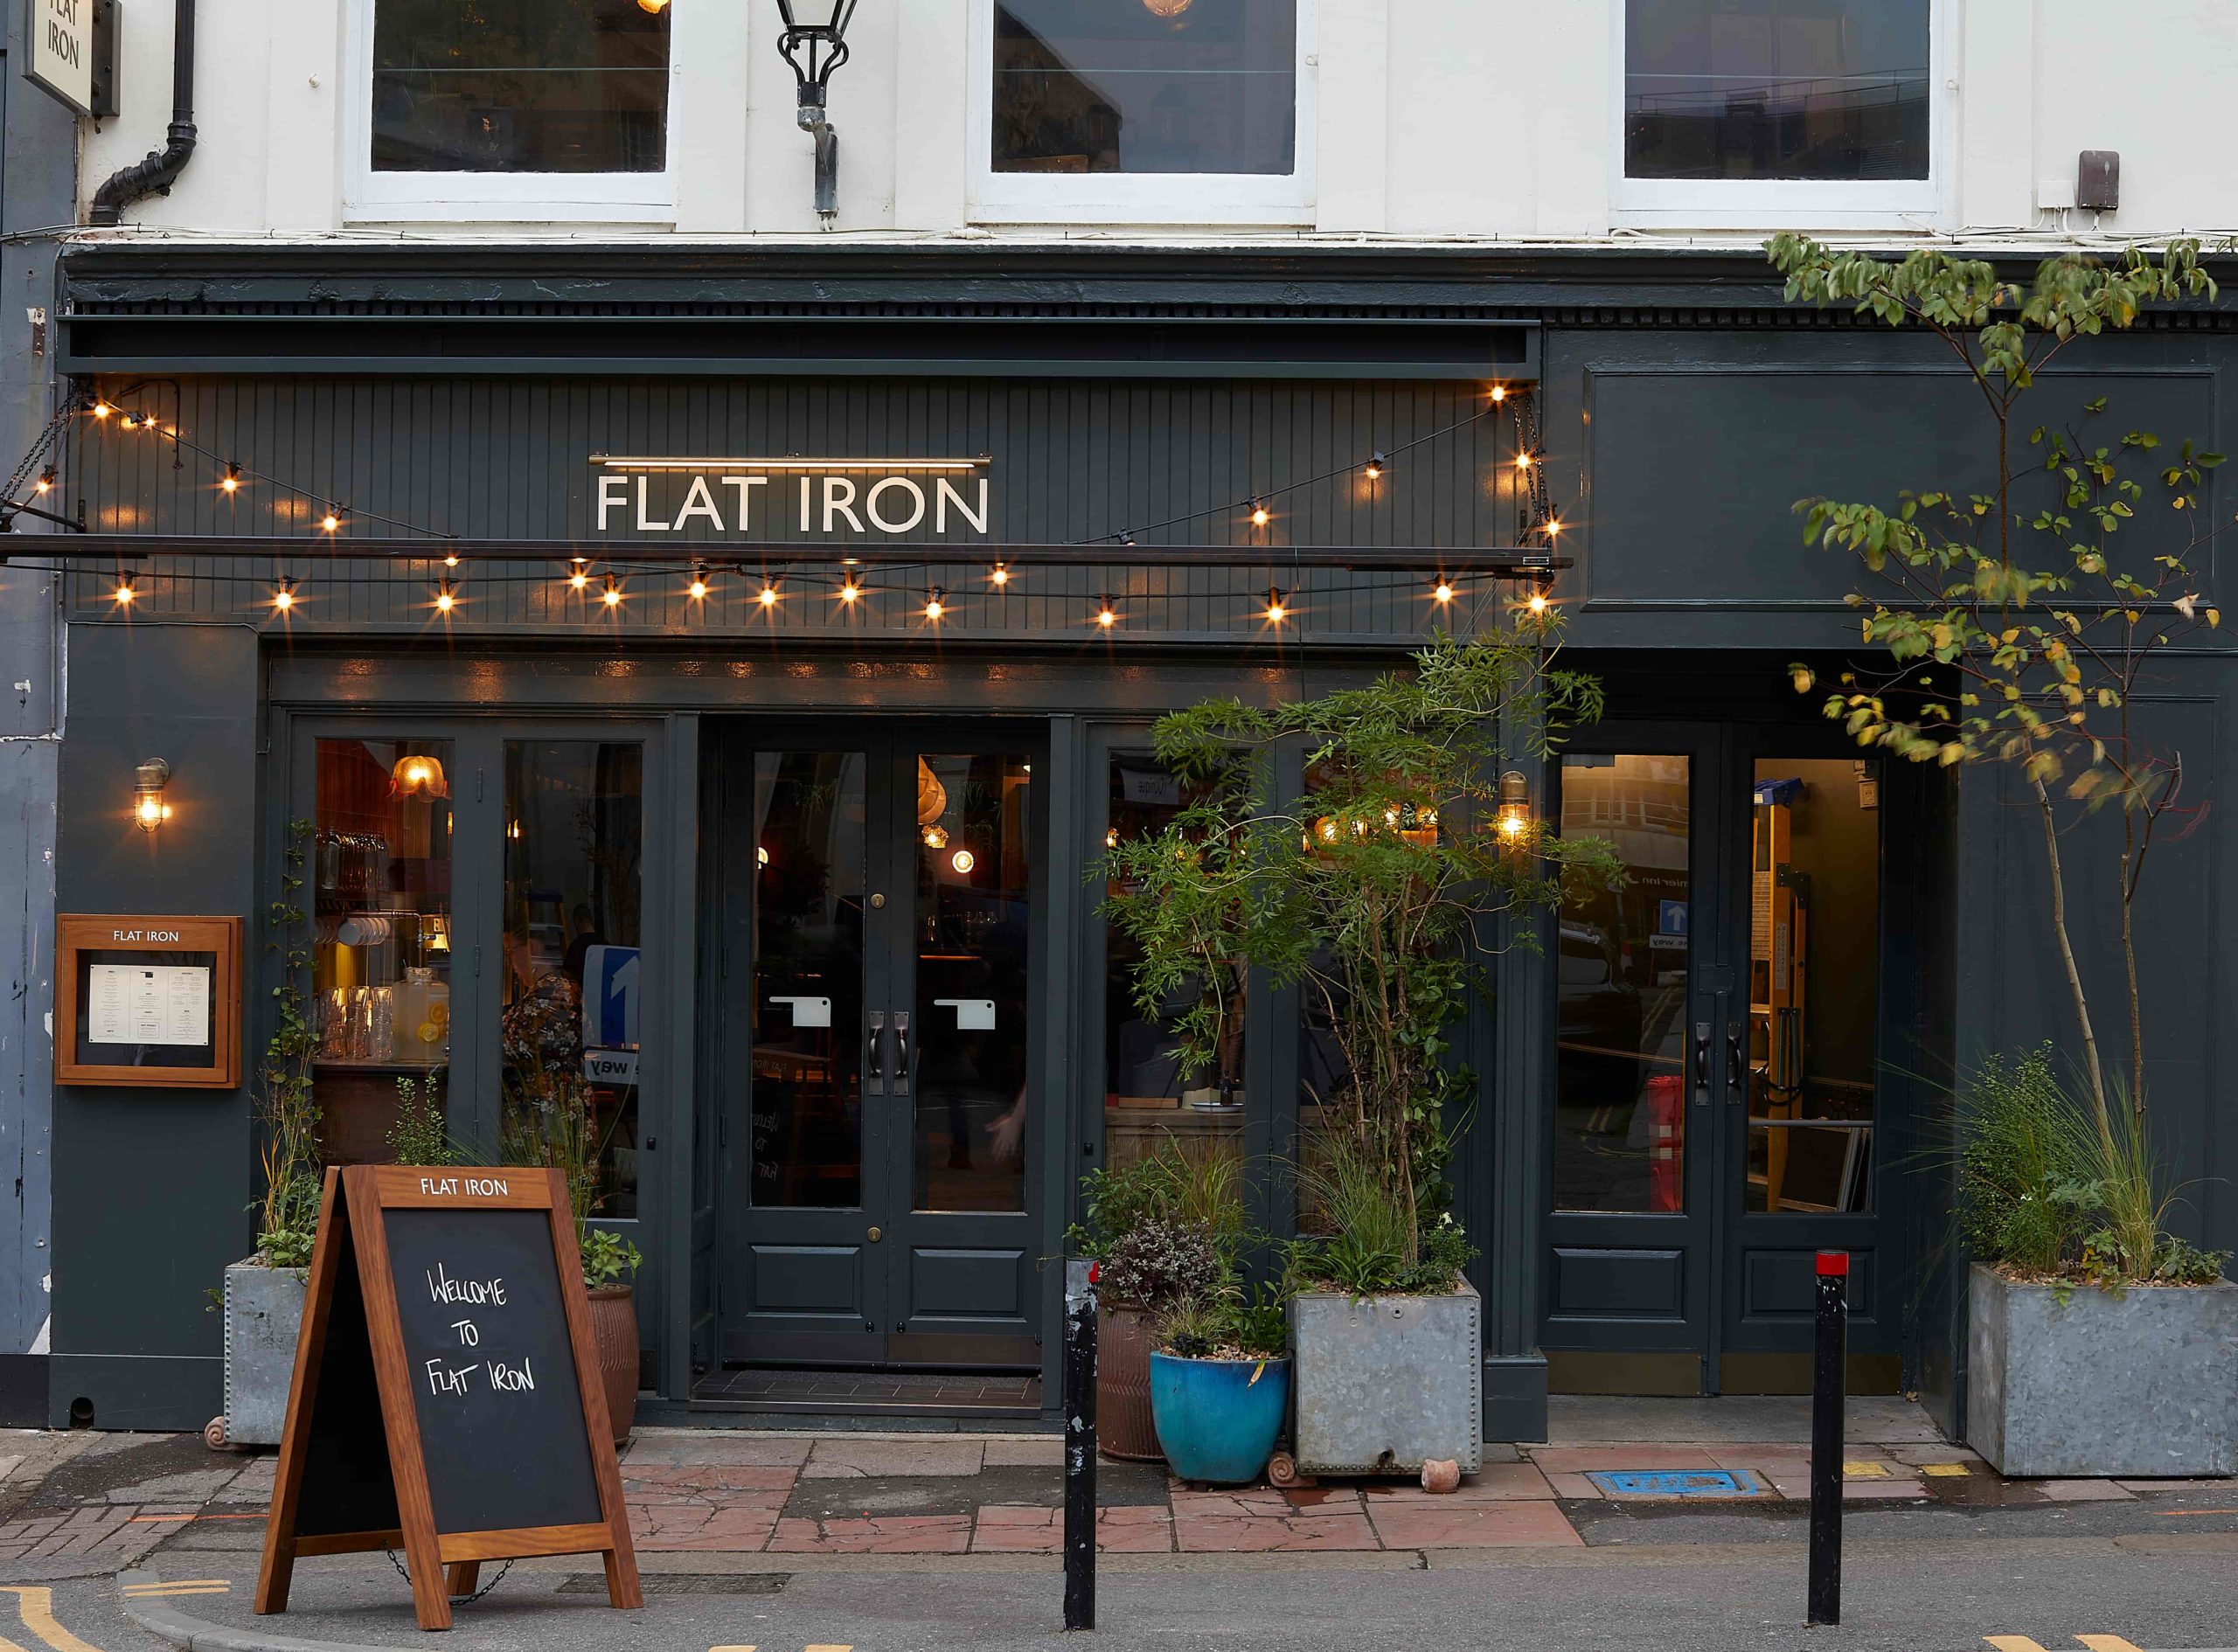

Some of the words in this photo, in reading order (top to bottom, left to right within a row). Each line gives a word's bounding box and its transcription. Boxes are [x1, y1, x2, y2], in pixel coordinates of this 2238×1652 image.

[50, 0, 79, 26] LAT
[48, 19, 80, 70] IRON
[596, 475, 768, 532] FLAT
[799, 476, 989, 534] IRON
[114, 930, 142, 941] FLAT
[147, 931, 179, 942] IRON
[420, 1177, 458, 1195] FLAT
[464, 1179, 508, 1197] IRON
[426, 1261, 507, 1307] WELCOME
[450, 1319, 479, 1347] TO
[425, 1357, 479, 1397] FLAT
[486, 1357, 535, 1392] IRON
